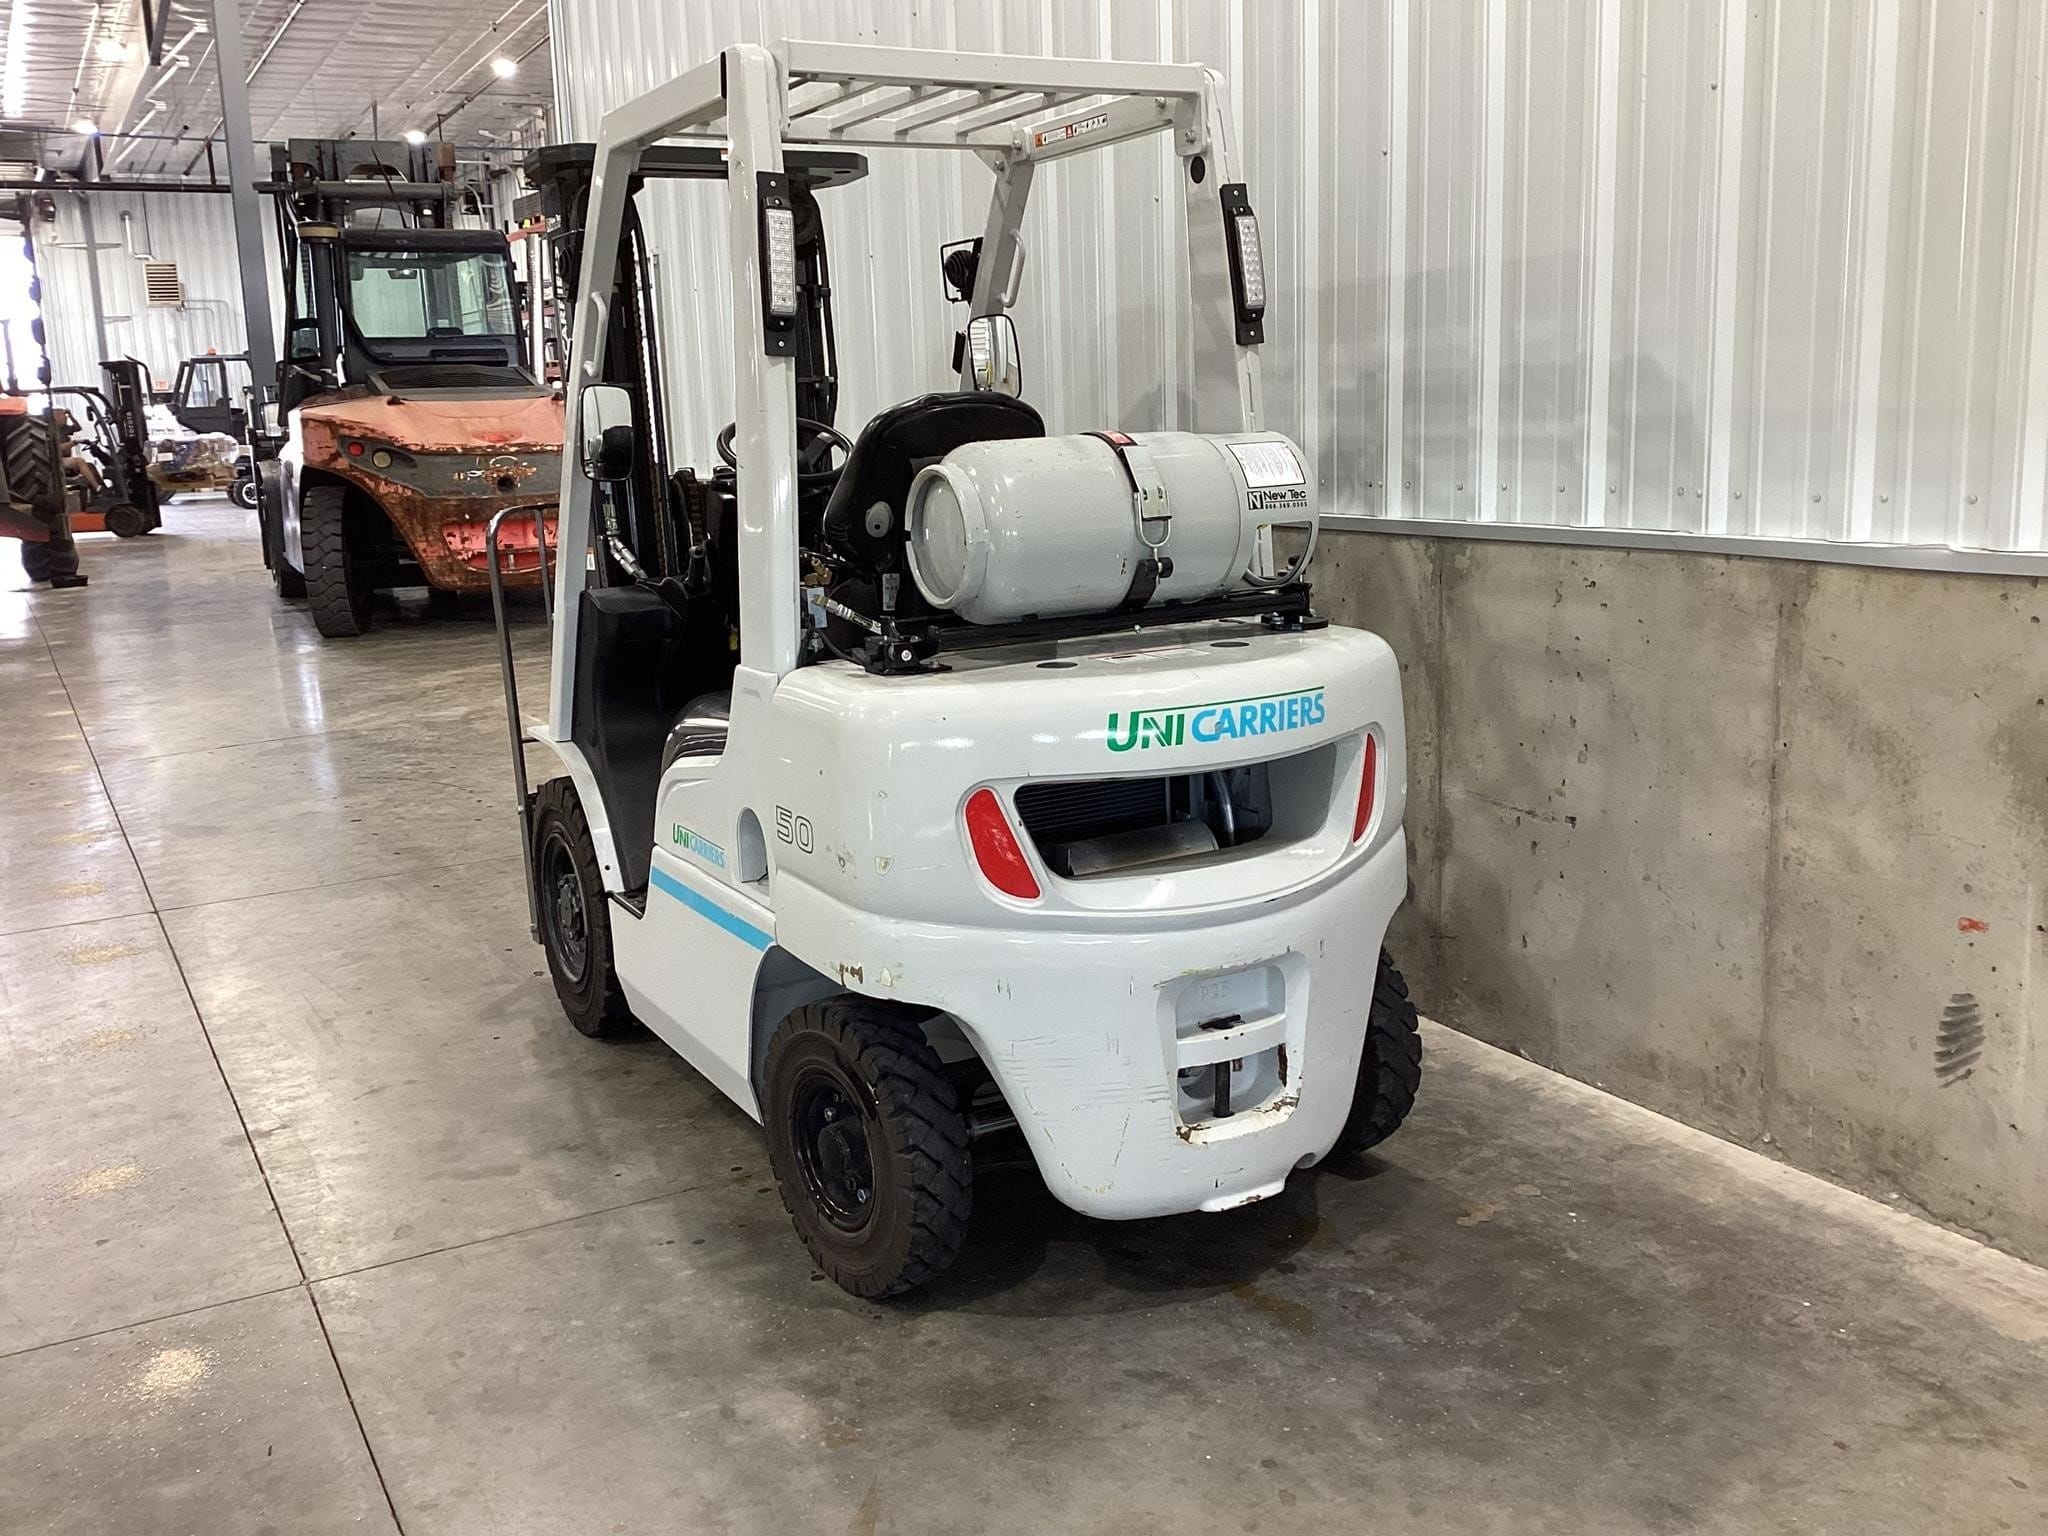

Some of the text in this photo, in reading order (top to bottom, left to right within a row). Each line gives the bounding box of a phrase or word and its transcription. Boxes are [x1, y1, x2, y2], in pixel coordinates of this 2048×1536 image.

[1263, 489, 1307, 500] New Tec
[776, 805, 813, 854] 50
